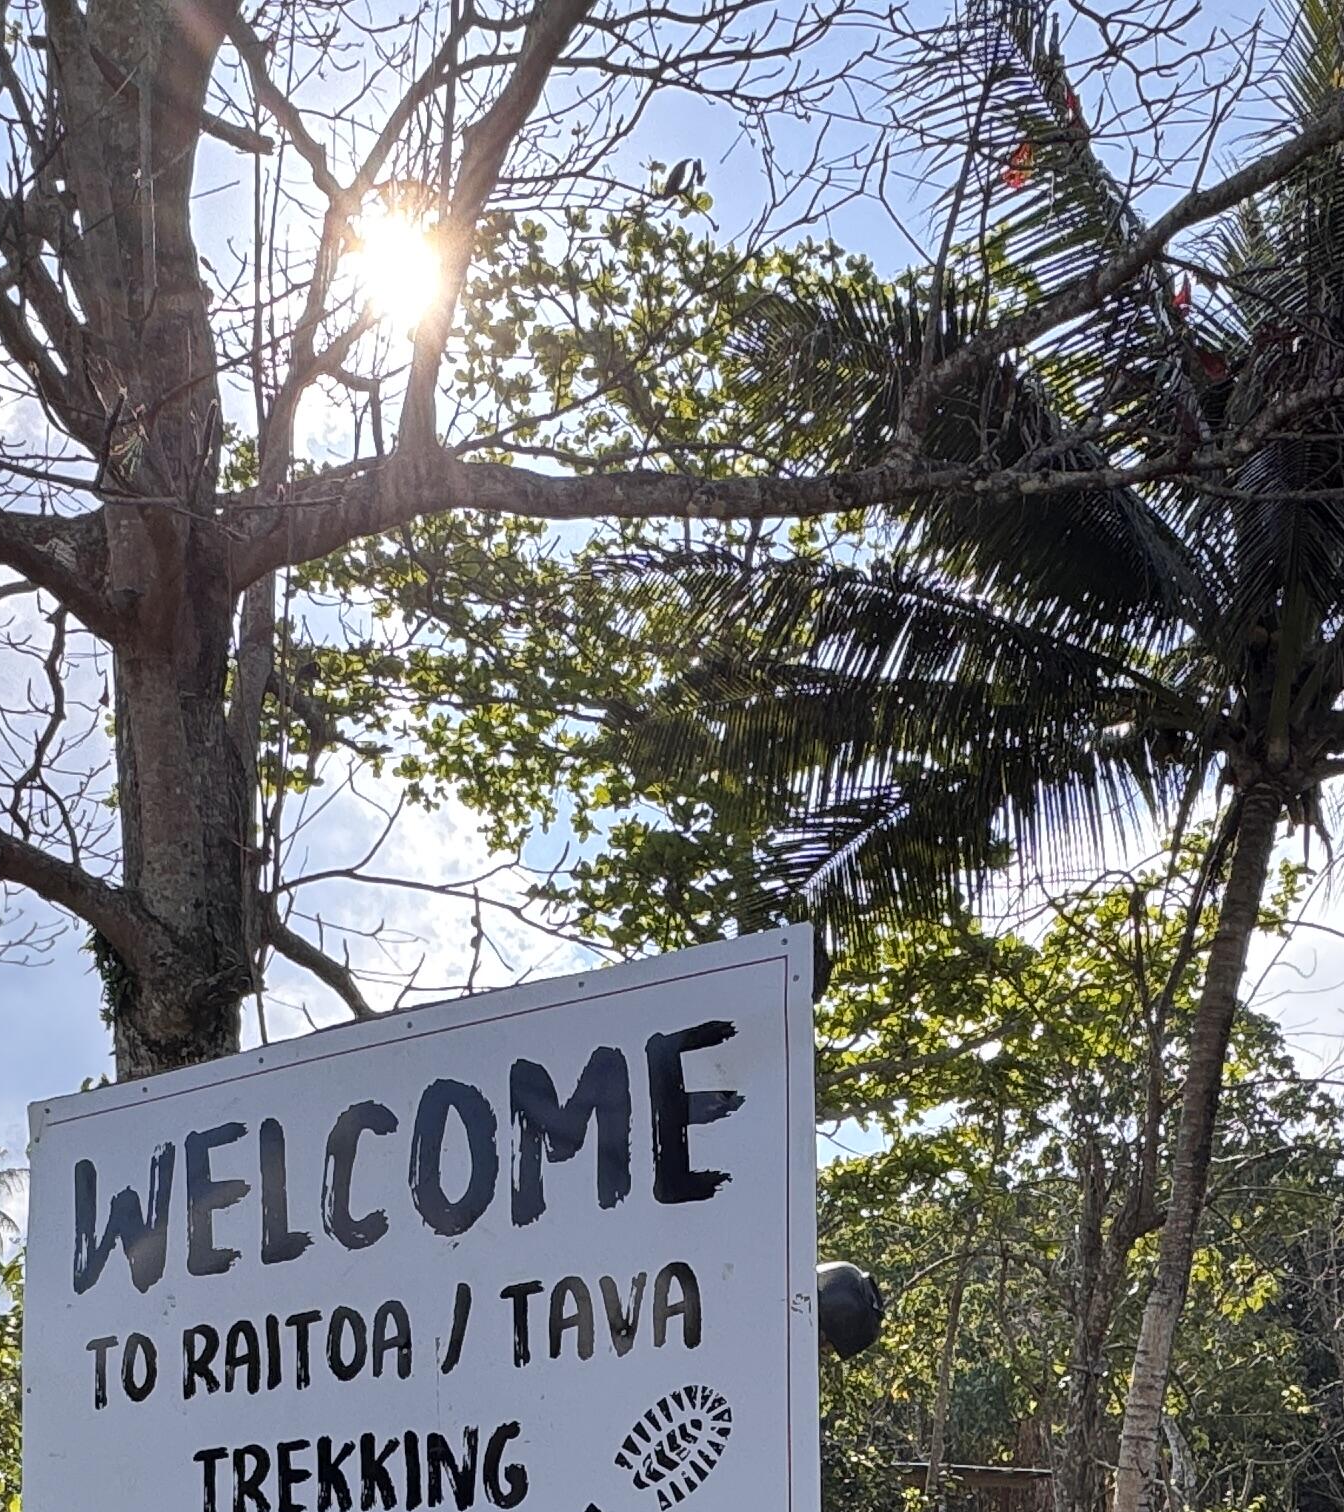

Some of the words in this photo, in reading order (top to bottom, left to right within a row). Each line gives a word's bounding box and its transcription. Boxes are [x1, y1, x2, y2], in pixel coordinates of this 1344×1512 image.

[74, 1020, 746, 1294] WELCOME
[86, 1335, 158, 1411] TO
[183, 1300, 413, 1400] RAITOA
[442, 1282, 472, 1375] /
[501, 1262, 703, 1369] TAVA
